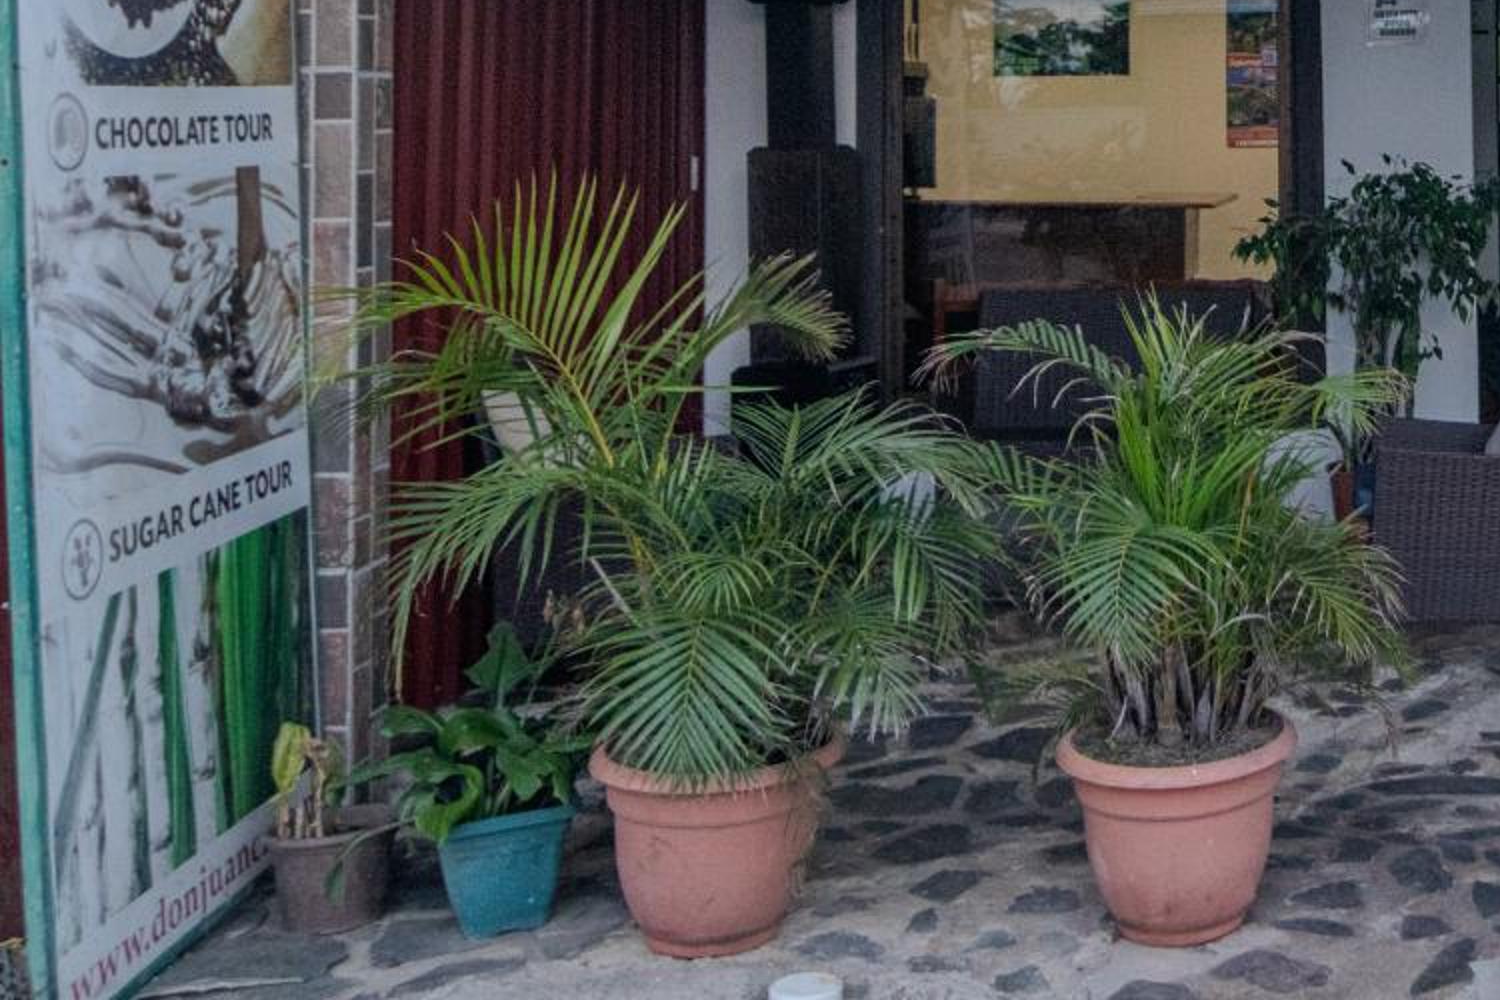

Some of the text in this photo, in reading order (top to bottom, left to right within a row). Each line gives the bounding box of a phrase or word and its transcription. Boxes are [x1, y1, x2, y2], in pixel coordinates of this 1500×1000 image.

[94, 112, 274, 149] CHOCOLATE TOUR
[109, 460, 294, 563] SUGAR CANE TOUR
[70, 834, 269, 1000] www.donjuanc
